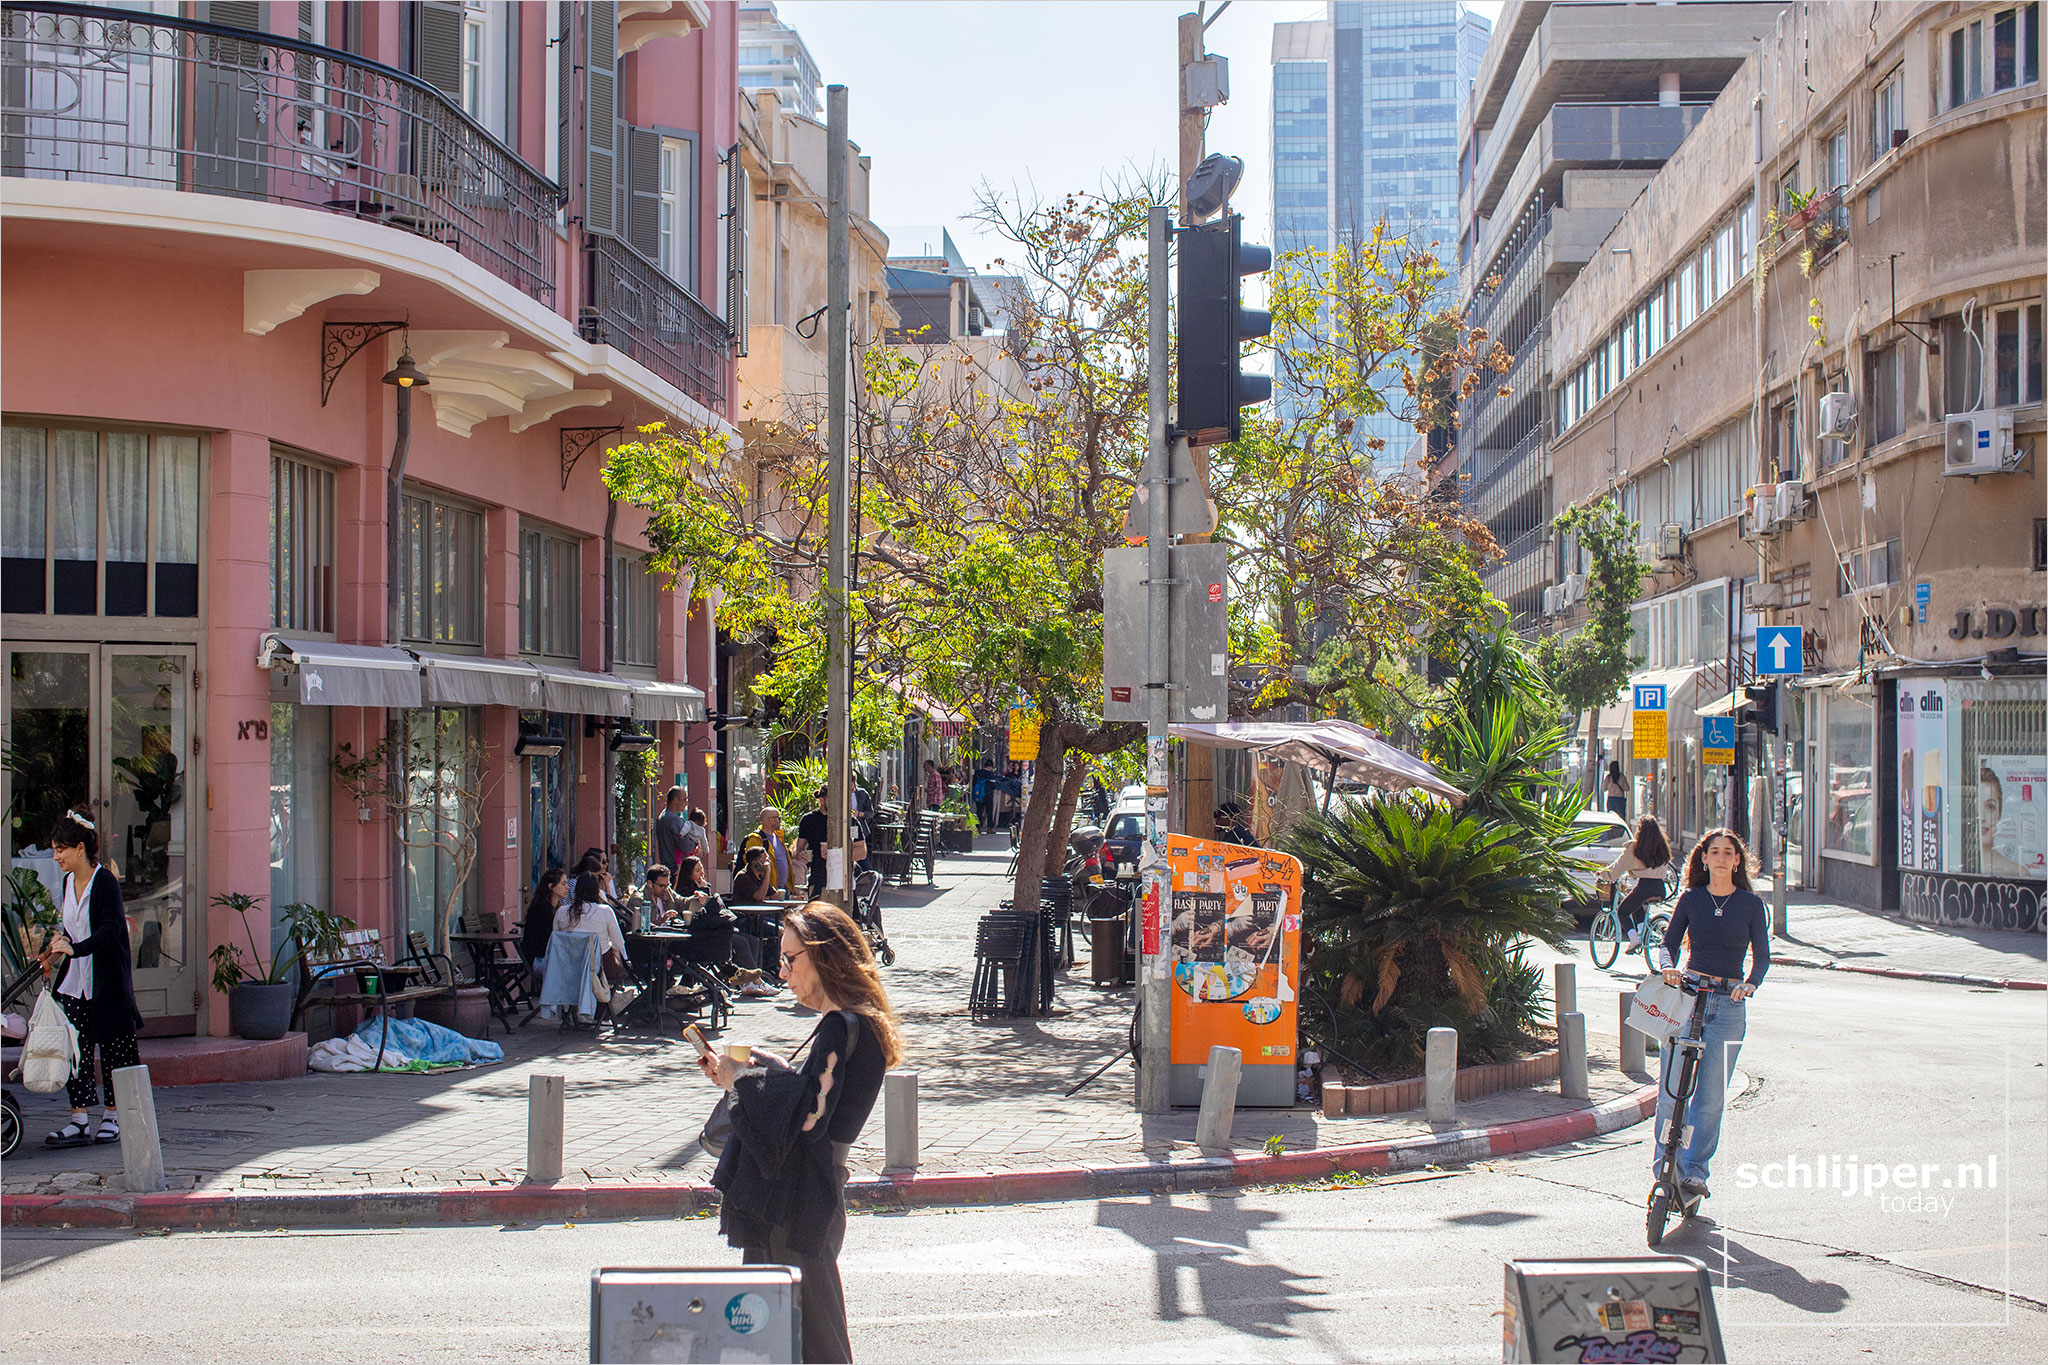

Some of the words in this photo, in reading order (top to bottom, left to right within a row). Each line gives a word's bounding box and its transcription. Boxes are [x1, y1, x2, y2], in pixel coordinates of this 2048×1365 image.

[1949, 607, 2046, 640] J.DI
[1920, 690, 1943, 711] allin
[1929, 820, 1937, 871] SOFT
[1199, 900, 1222, 910] PARTY
[1660, 1012, 1681, 1027] Pharm
